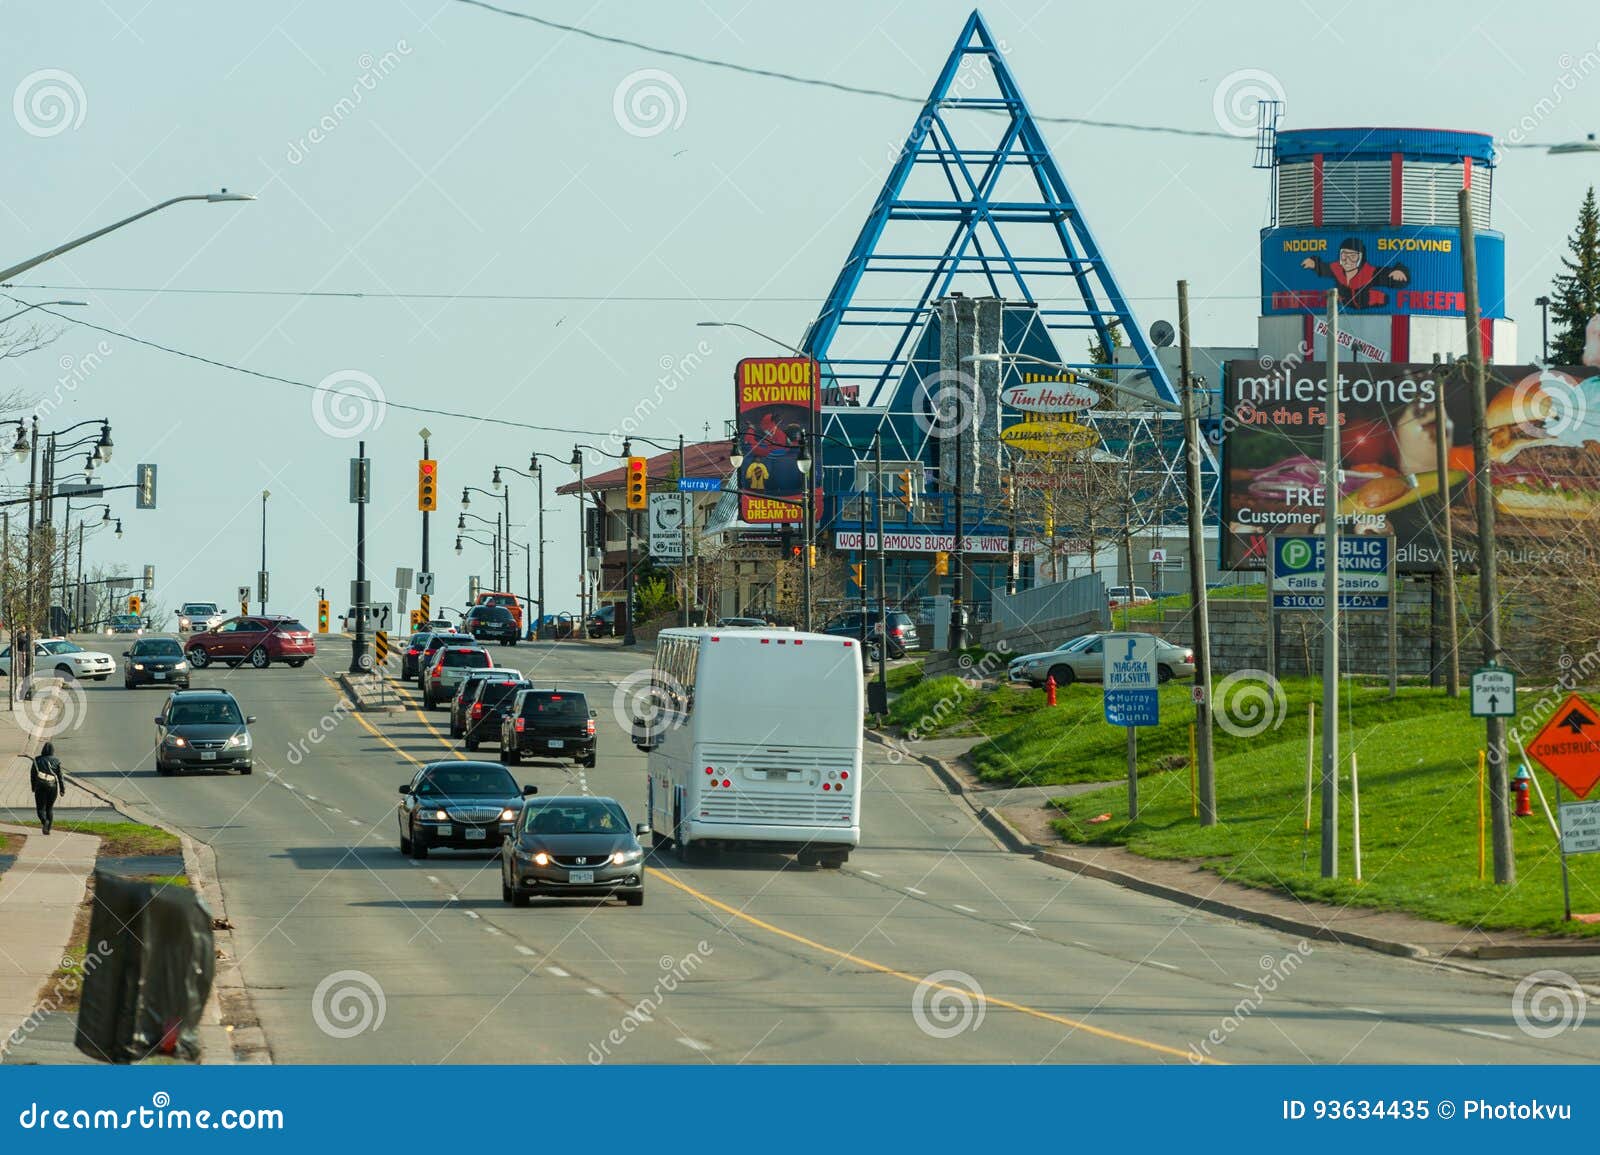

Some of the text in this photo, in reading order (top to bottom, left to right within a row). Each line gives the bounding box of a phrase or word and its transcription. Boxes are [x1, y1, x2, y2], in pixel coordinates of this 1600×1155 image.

[1283, 238, 1452, 252] INDOOR SKYDIVING
[1316, 322, 1352, 346] PAIESS
[744, 363, 816, 385] INDOOR
[1238, 369, 1436, 403] milestones
[743, 386, 816, 402] SKYDIVING
[1010, 388, 1092, 407] Tim Hortons
[1239, 406, 1346, 425] On the Fas
[680, 480, 709, 489] Murray
[1285, 488, 1326, 507] FRE
[747, 509, 783, 520] DREAM
[786, 509, 798, 519] TO
[1237, 508, 1386, 529] Customer arking
[882, 536, 921, 549] AMOUS
[981, 538, 1009, 552] WING
[1316, 541, 1381, 555] PBLIC
[1150, 551, 1164, 562] A
[1396, 544, 1586, 564] allsvew oulevard
[1316, 557, 1382, 569] PRKING
[1288, 578, 1318, 588] Falls
[1352, 596, 1378, 607] DAY
[1113, 661, 1148, 672] NIAGARA
[1110, 672, 1151, 683] FALLSVIEW
[1482, 674, 1504, 682] Falls
[1476, 685, 1511, 694] Parking
[1117, 694, 1150, 704] Murray
[1117, 704, 1145, 712] Main
[1117, 713, 1149, 721] Dunn
